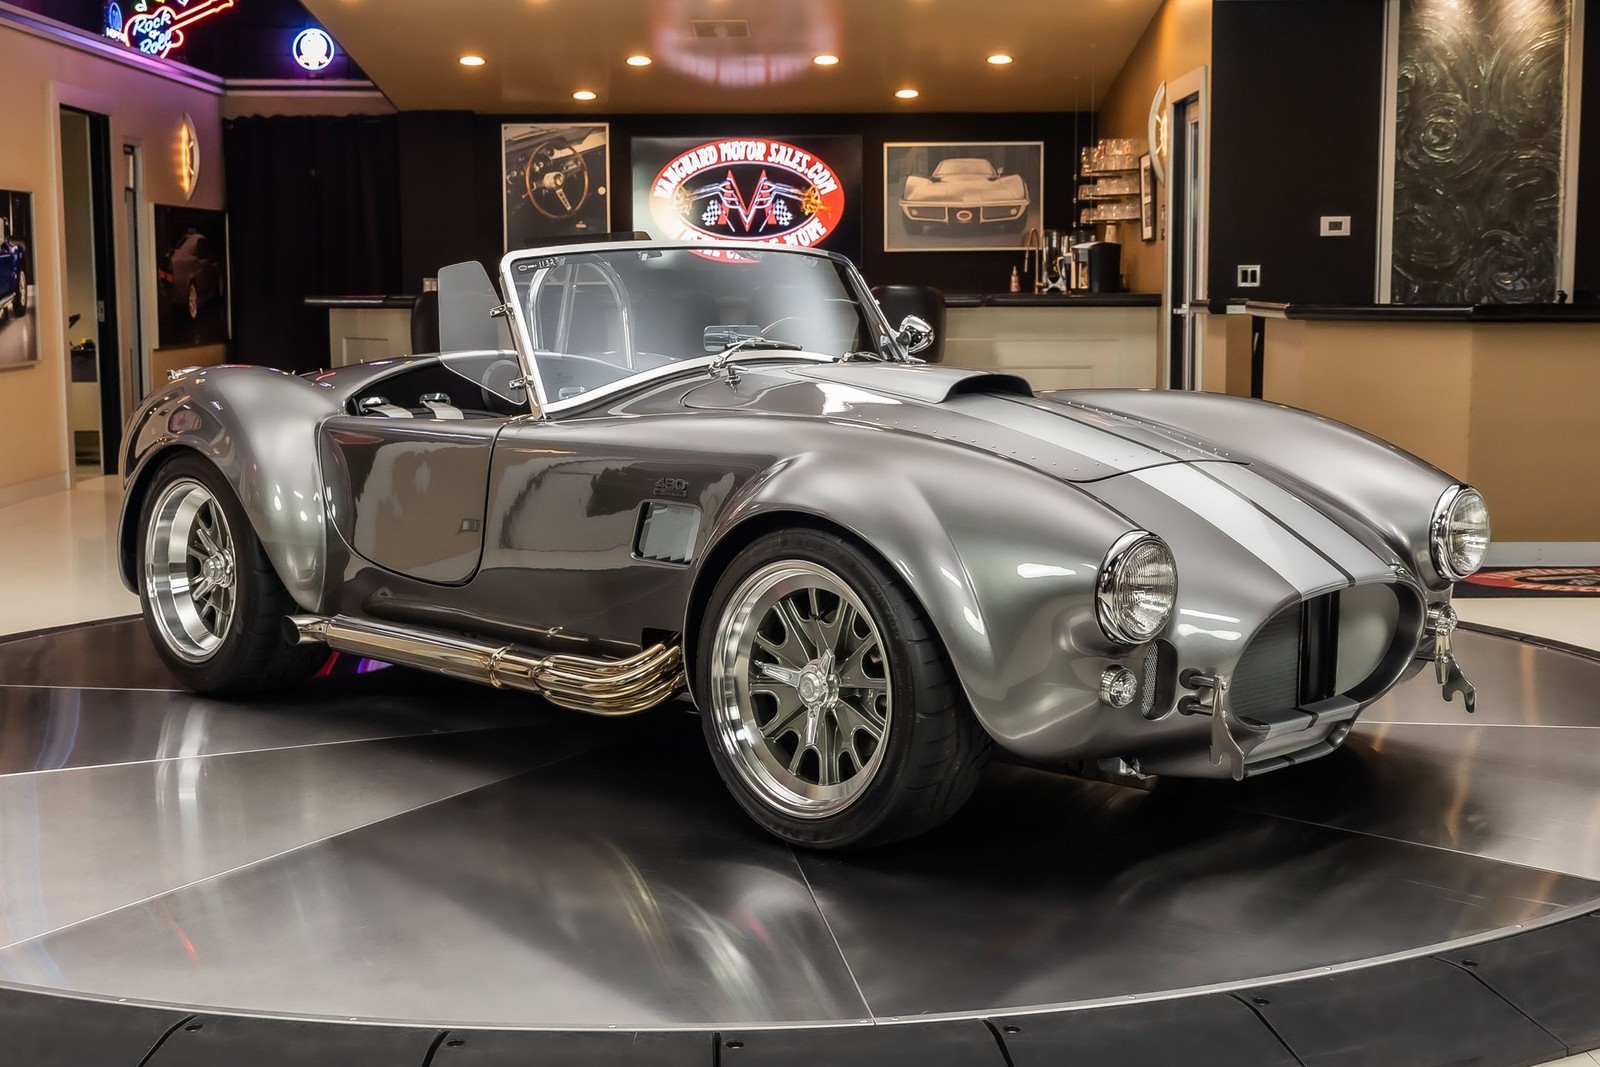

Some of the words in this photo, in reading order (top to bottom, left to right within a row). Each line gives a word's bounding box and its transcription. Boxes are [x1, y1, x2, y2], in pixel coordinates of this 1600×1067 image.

[133, 10, 171, 36] Rock
[140, 30, 171, 54] Roll
[653, 145, 719, 198] VANGUARD
[718, 140, 767, 162] MOTOR
[767, 142, 838, 195] SALES.COM
